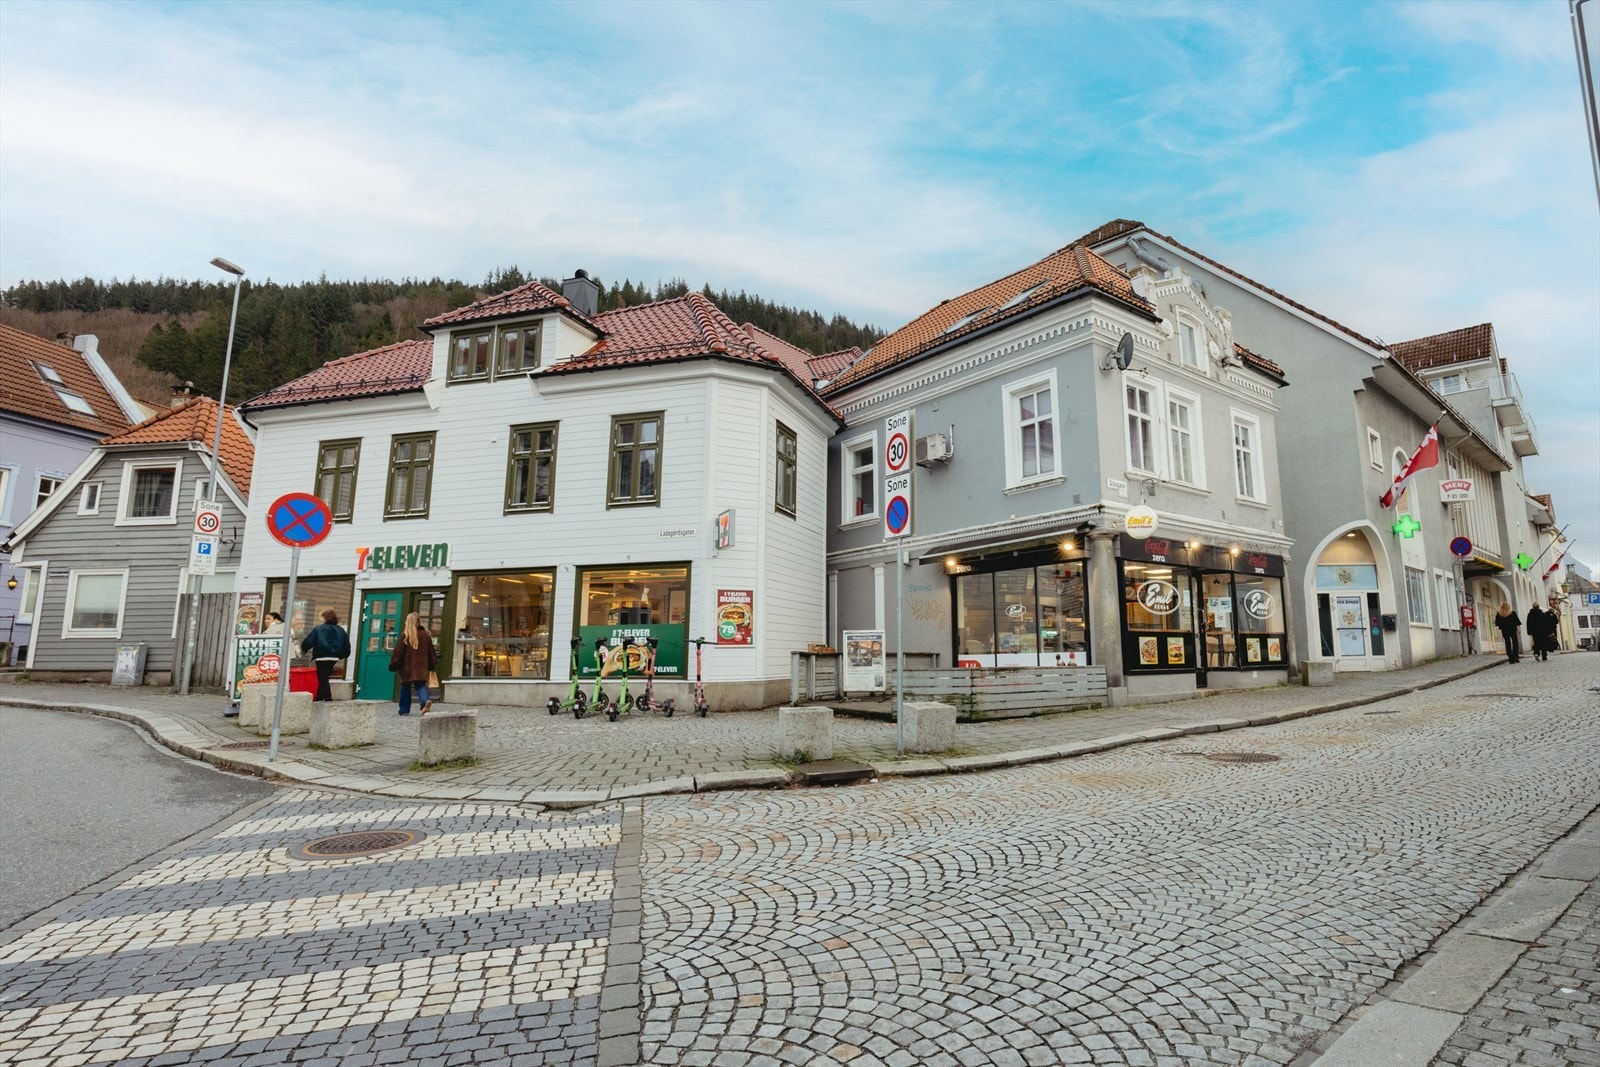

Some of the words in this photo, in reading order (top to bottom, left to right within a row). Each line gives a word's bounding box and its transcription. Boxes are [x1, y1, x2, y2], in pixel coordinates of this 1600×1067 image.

[888, 416, 906, 431] Sone
[890, 442, 904, 462] 30
[888, 480, 908, 492] Sone
[1444, 482, 1469, 490] MENY
[201, 502, 220, 512] Sone
[201, 516, 215, 528] 30
[1127, 516, 1152, 525] Emil's
[660, 530, 694, 538] Ladegårdsgaten
[201, 544, 208, 553] P
[1146, 583, 1173, 606] Emil
[1251, 592, 1270, 613] Emil
[239, 639, 283, 648] NYHET
